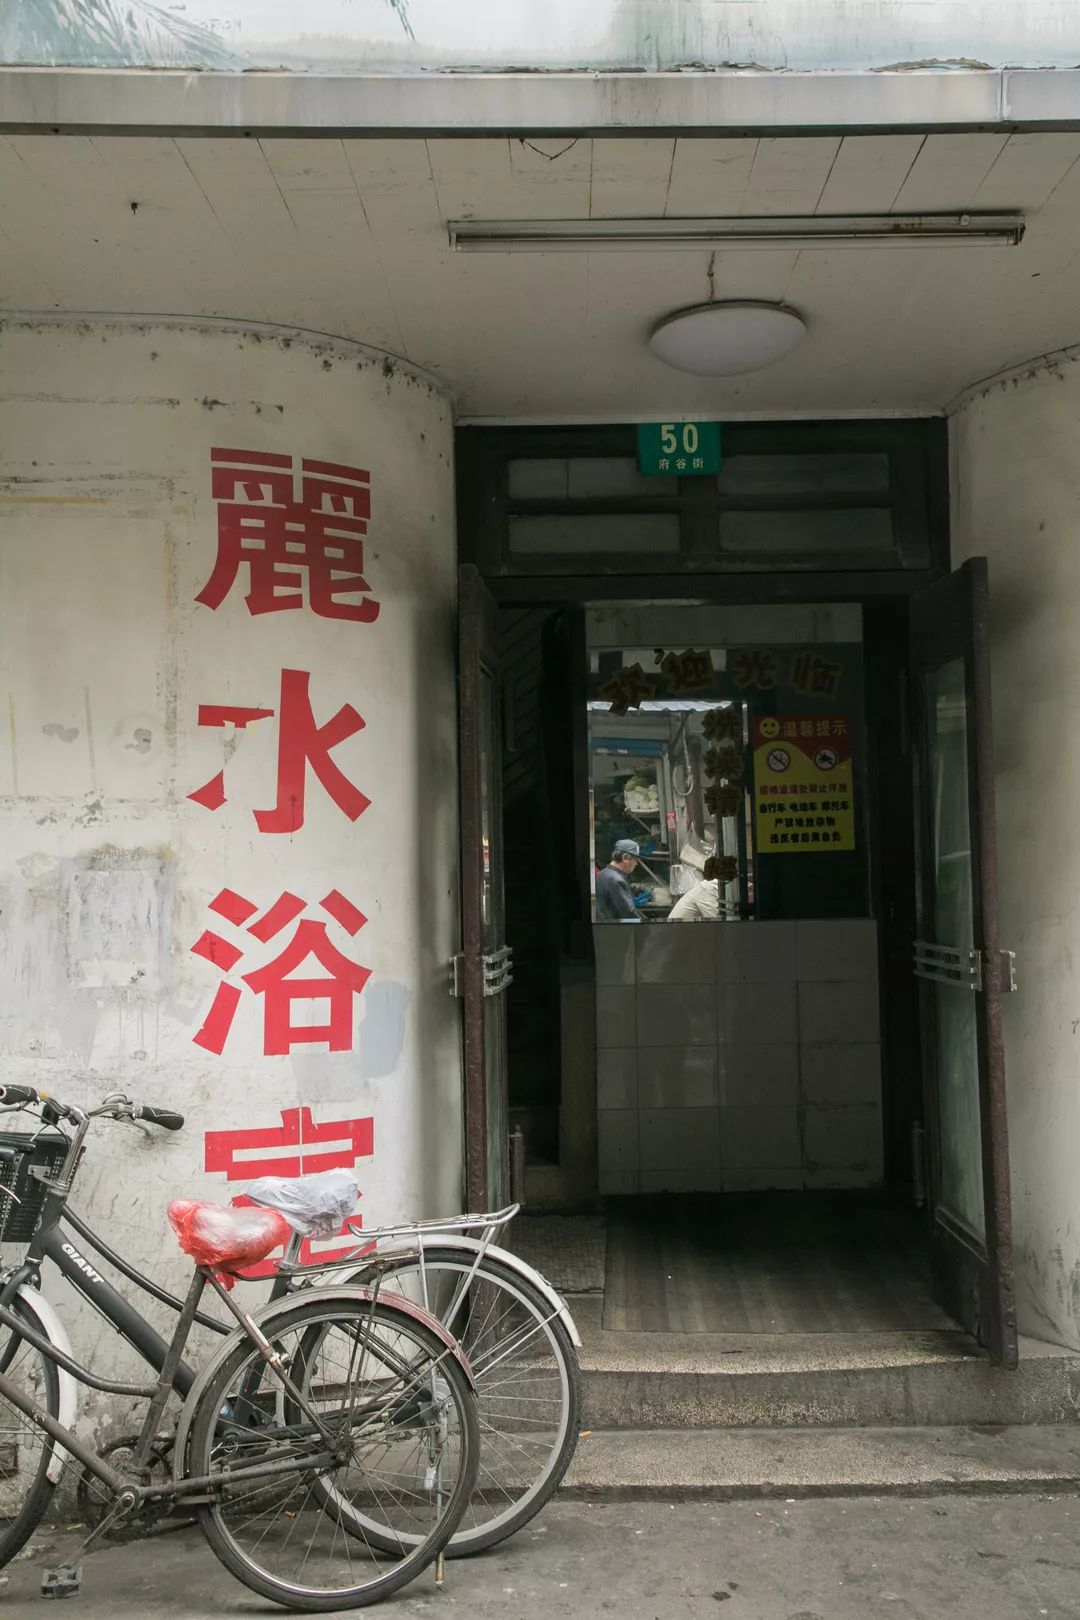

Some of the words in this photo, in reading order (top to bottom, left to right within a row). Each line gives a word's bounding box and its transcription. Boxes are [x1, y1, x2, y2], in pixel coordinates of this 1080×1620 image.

[661, 423, 699, 454] 50
[658, 457, 704, 470] 府谷街
[783, 720, 847, 737] 温馨提示
[61, 1243, 105, 1283] GIANT
